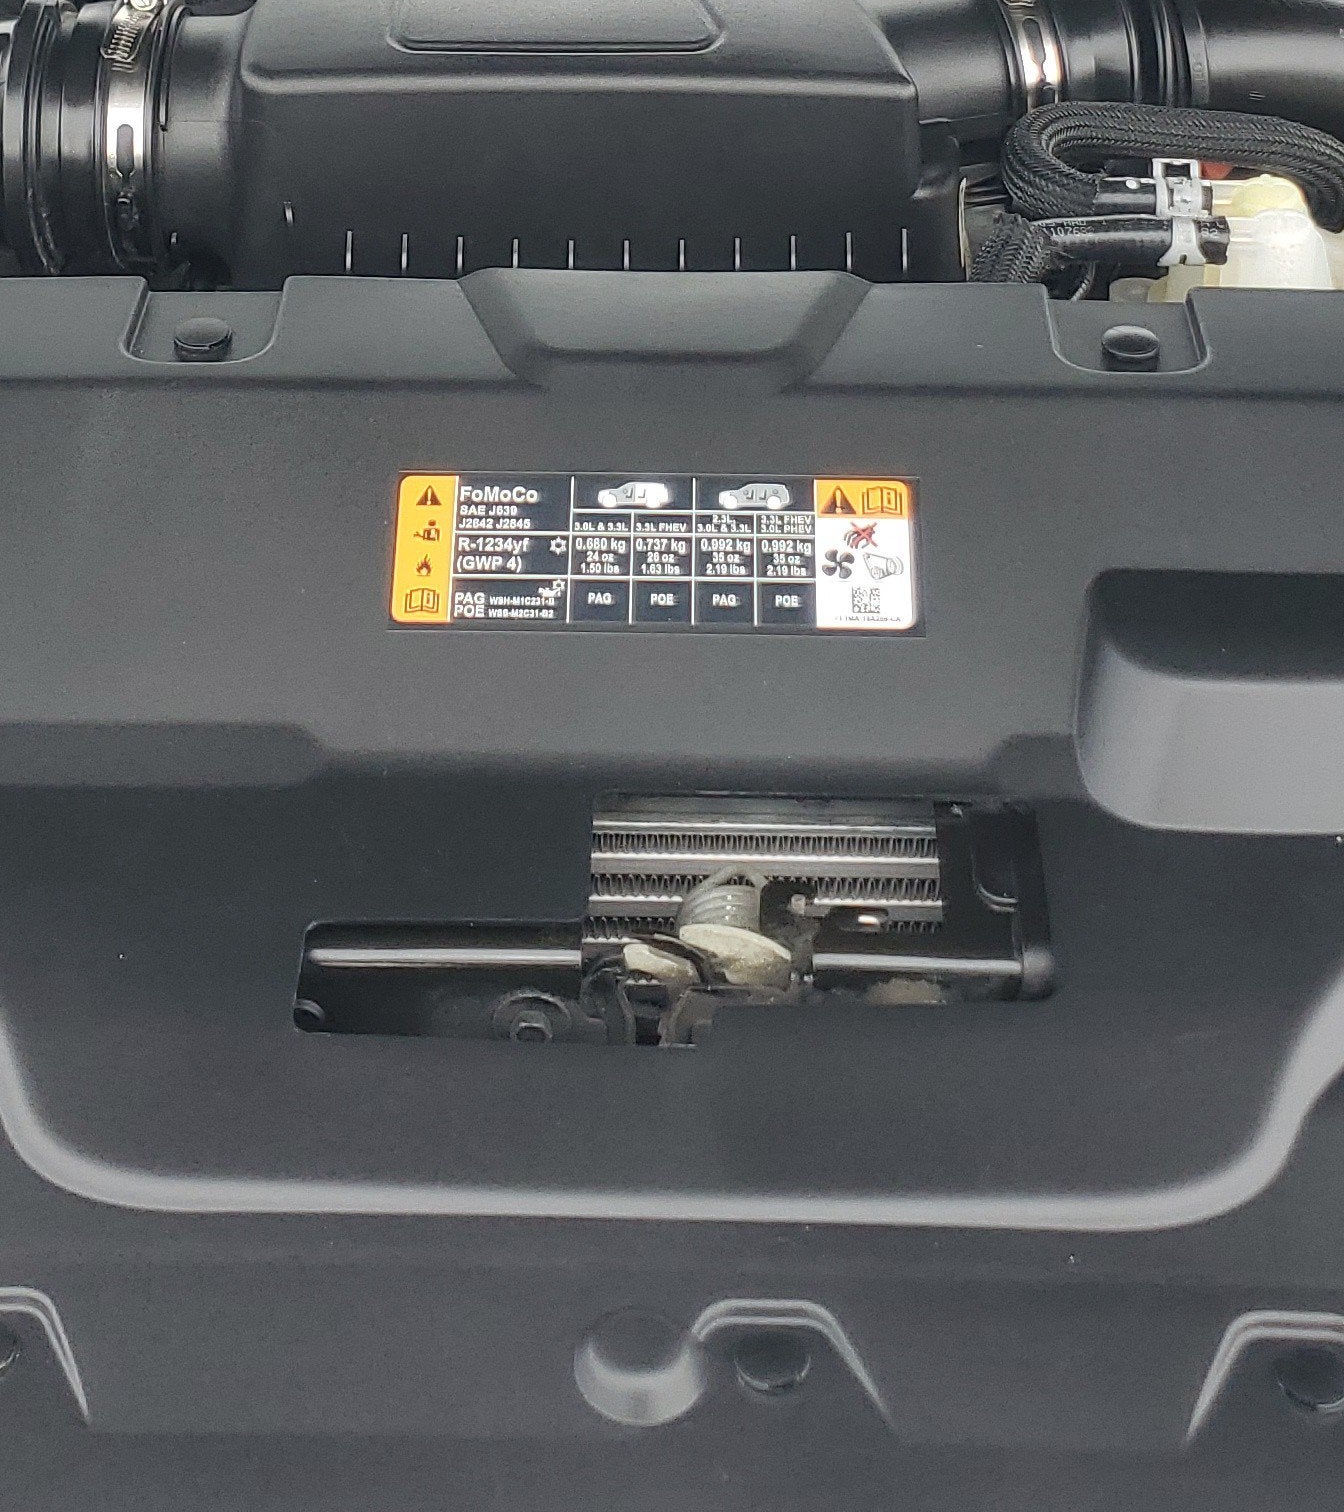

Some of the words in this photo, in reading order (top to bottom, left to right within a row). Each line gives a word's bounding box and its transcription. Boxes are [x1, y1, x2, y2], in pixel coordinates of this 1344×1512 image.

[459, 485, 539, 503] FoMoCo
[459, 505, 486, 516] SAE
[489, 505, 518, 516] J639
[495, 518, 531, 529] J2845
[760, 515, 782, 524] 3.3L
[784, 515, 812, 524] FHEV
[574, 522, 595, 531] 3.0L
[597, 522, 605, 531] &
[607, 522, 629, 531] 3.3L
[635, 522, 657, 532] 3.3L
[659, 522, 687, 532] FHEV
[697, 524, 719, 533] 3.0L
[721, 524, 728, 533] &
[730, 524, 752, 534] 3.3L
[760, 524, 782, 534] 3.0L
[784, 524, 812, 534] PHEV
[458, 537, 530, 554] R-1234yf
[610, 538, 626, 553] kg
[635, 538, 668, 551] 0.737
[670, 538, 686, 554] kg
[736, 539, 751, 554] kg
[761, 539, 795, 552] 0.992
[797, 540, 812, 555] kg
[586, 552, 600, 562] 24
[602, 553, 614, 563] oz
[663, 554, 675, 563] oz
[712, 553, 725, 563] 35
[727, 554, 740, 564] oz
[773, 554, 786, 564] 35
[787, 555, 801, 564] oz
[457, 556, 503, 573] (GWP
[506, 556, 522, 573] 4)
[580, 563, 601, 574] 1.50
[603, 563, 620, 574] lbs
[641, 563, 662, 574] 1.63
[664, 564, 681, 575] lbs
[706, 564, 727, 575] 2.19
[729, 564, 746, 575] lbs
[766, 565, 788, 576] 2.19
[790, 565, 807, 576] lbs
[454, 592, 485, 605] PAG
[588, 592, 613, 605] PAG
[650, 593, 675, 605] POE
[712, 594, 737, 606] PAG
[775, 595, 800, 607] POE
[453, 605, 485, 618] POE
